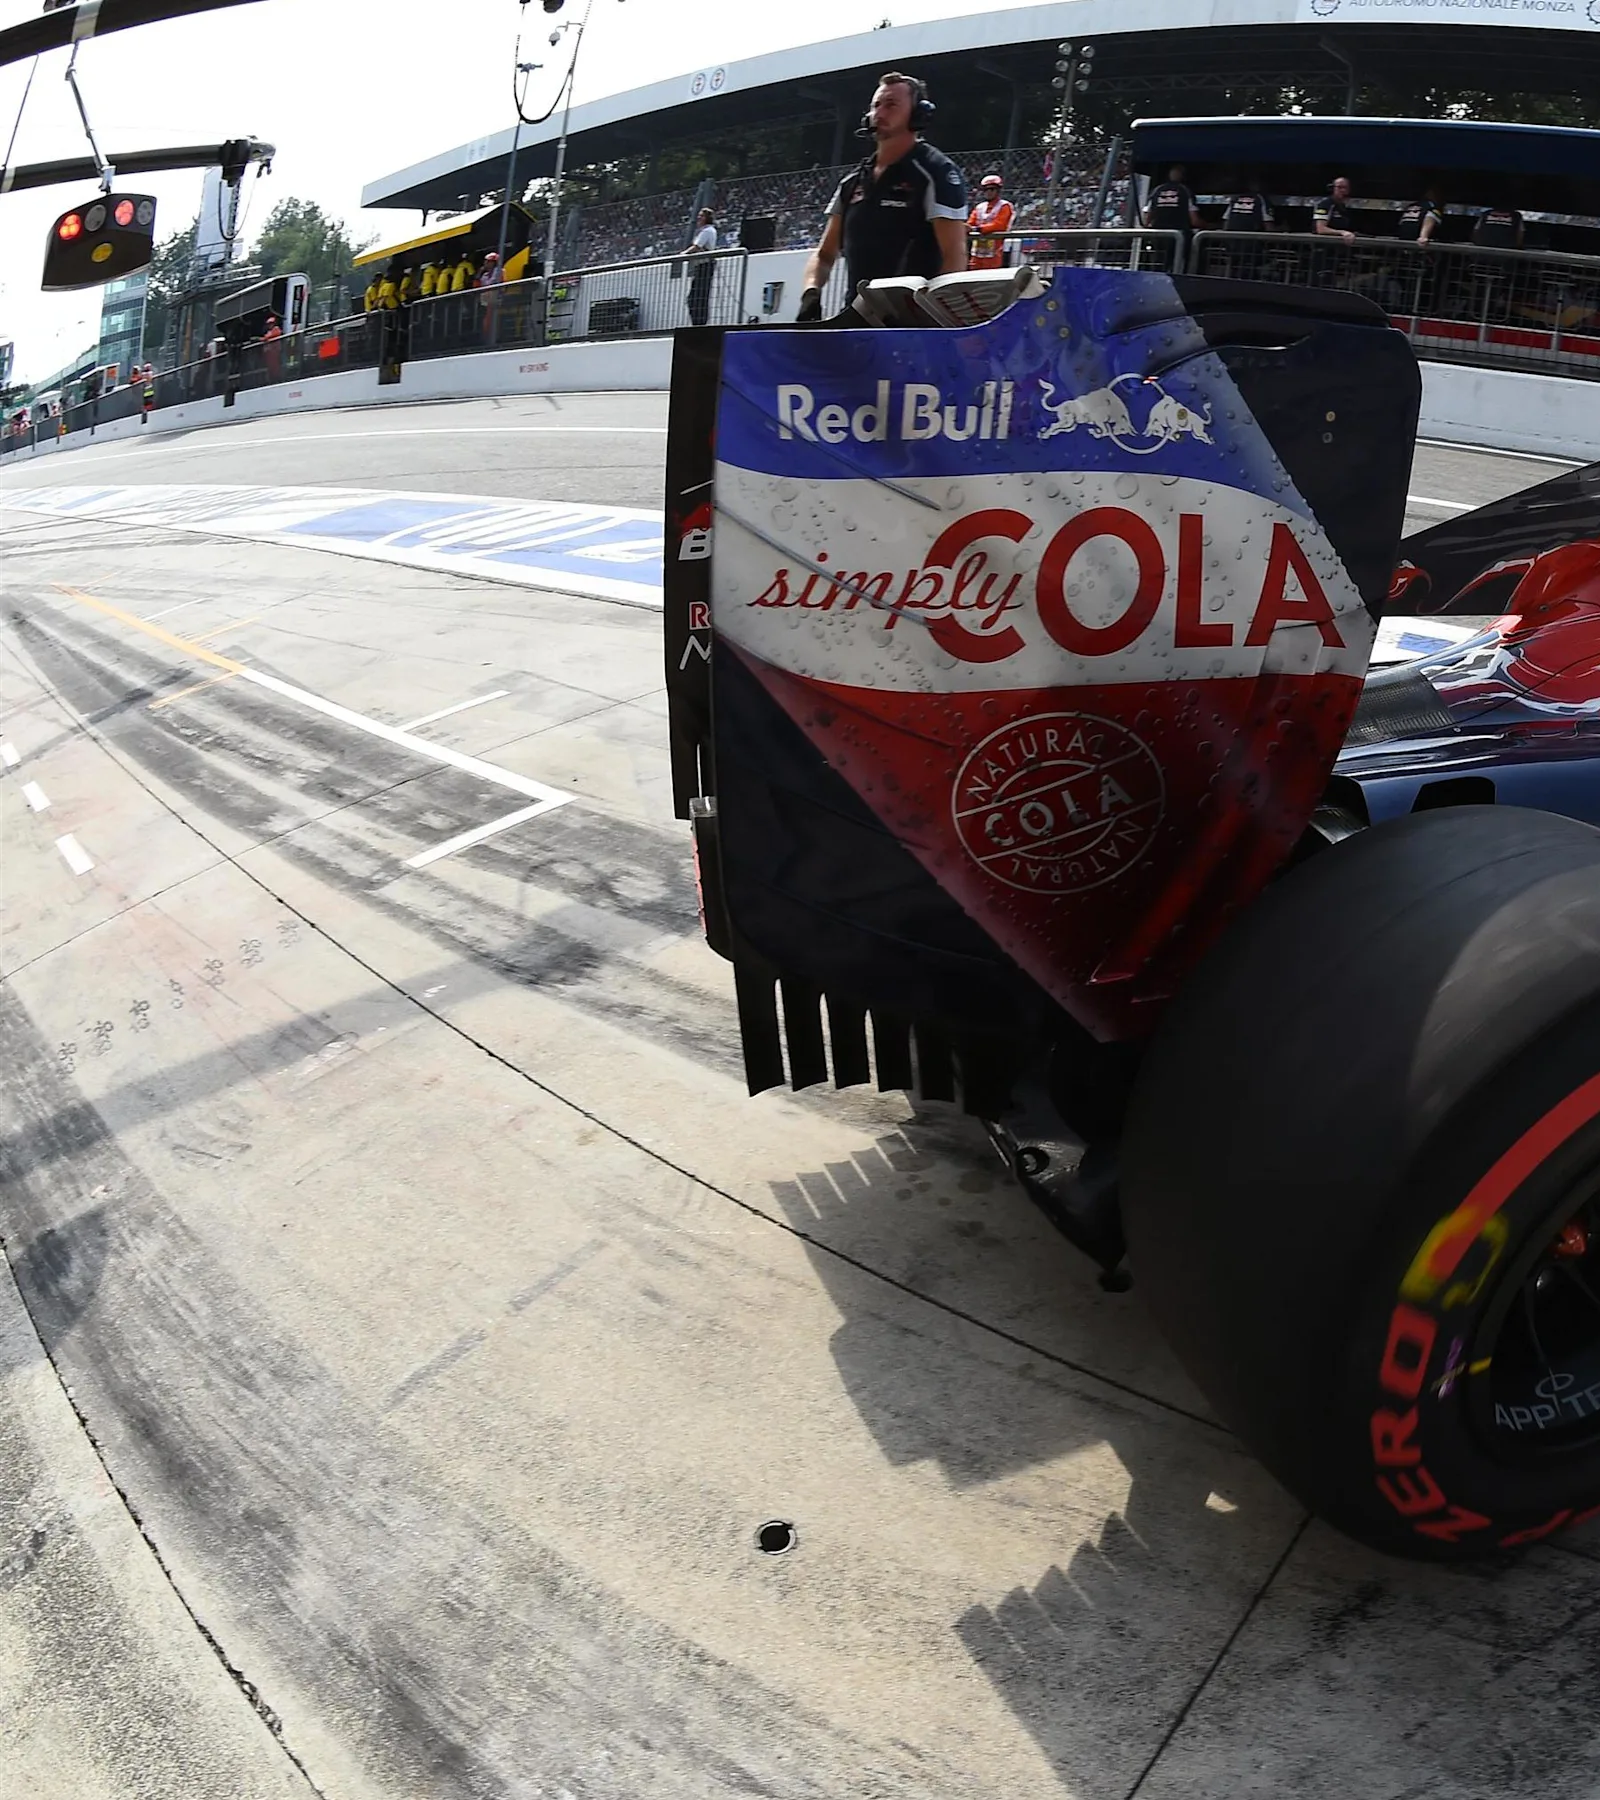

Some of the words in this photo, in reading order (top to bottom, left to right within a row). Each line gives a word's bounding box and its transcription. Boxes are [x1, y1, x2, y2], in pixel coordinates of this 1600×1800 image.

[1522, 1, 1577, 13] MONZA
[776, 380, 889, 443] Red
[901, 379, 1014, 442] Bull
[747, 551, 1023, 630] simply
[924, 506, 1347, 663] COLA
[984, 774, 1133, 846] COLA
[1371, 1303, 1492, 1543] ZERO
